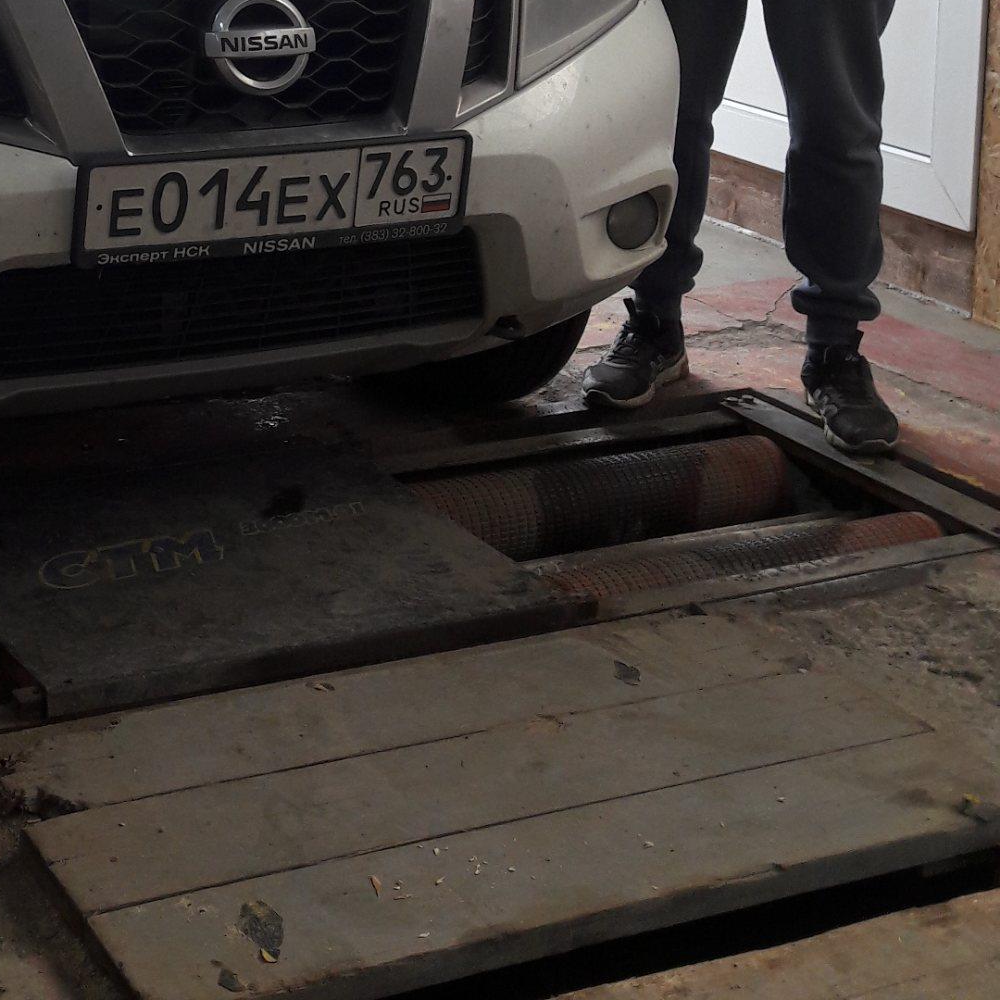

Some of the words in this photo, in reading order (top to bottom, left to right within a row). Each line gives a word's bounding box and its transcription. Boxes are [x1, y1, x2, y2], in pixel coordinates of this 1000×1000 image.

[220, 33, 308, 53] NISSAN
[365, 146, 448, 200] 763
[378, 197, 420, 217] RUS
[243, 236, 316, 256] NISSAN
[97, 249, 169, 265] Эксперт
